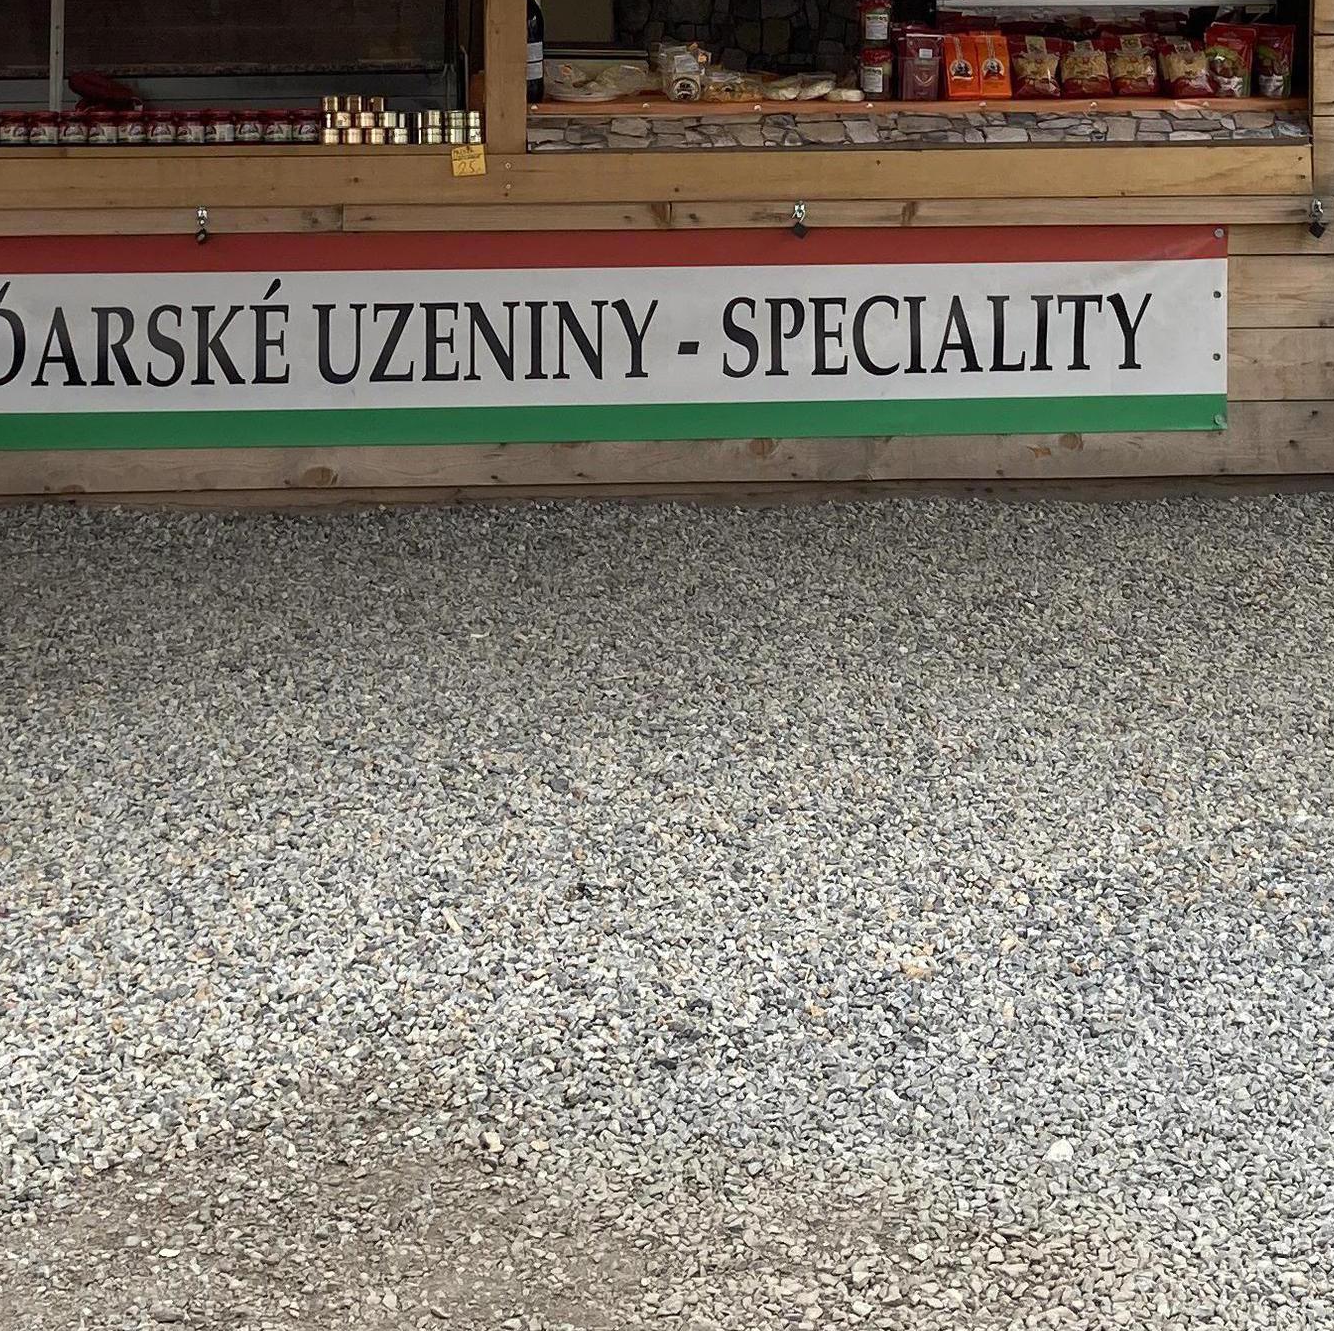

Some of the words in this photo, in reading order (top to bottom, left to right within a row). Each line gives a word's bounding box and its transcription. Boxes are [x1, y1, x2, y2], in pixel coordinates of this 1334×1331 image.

[312, 298, 659, 384] UZENINY
[677, 340, 700, 356] -
[722, 292, 1153, 379] SPECIALITY
